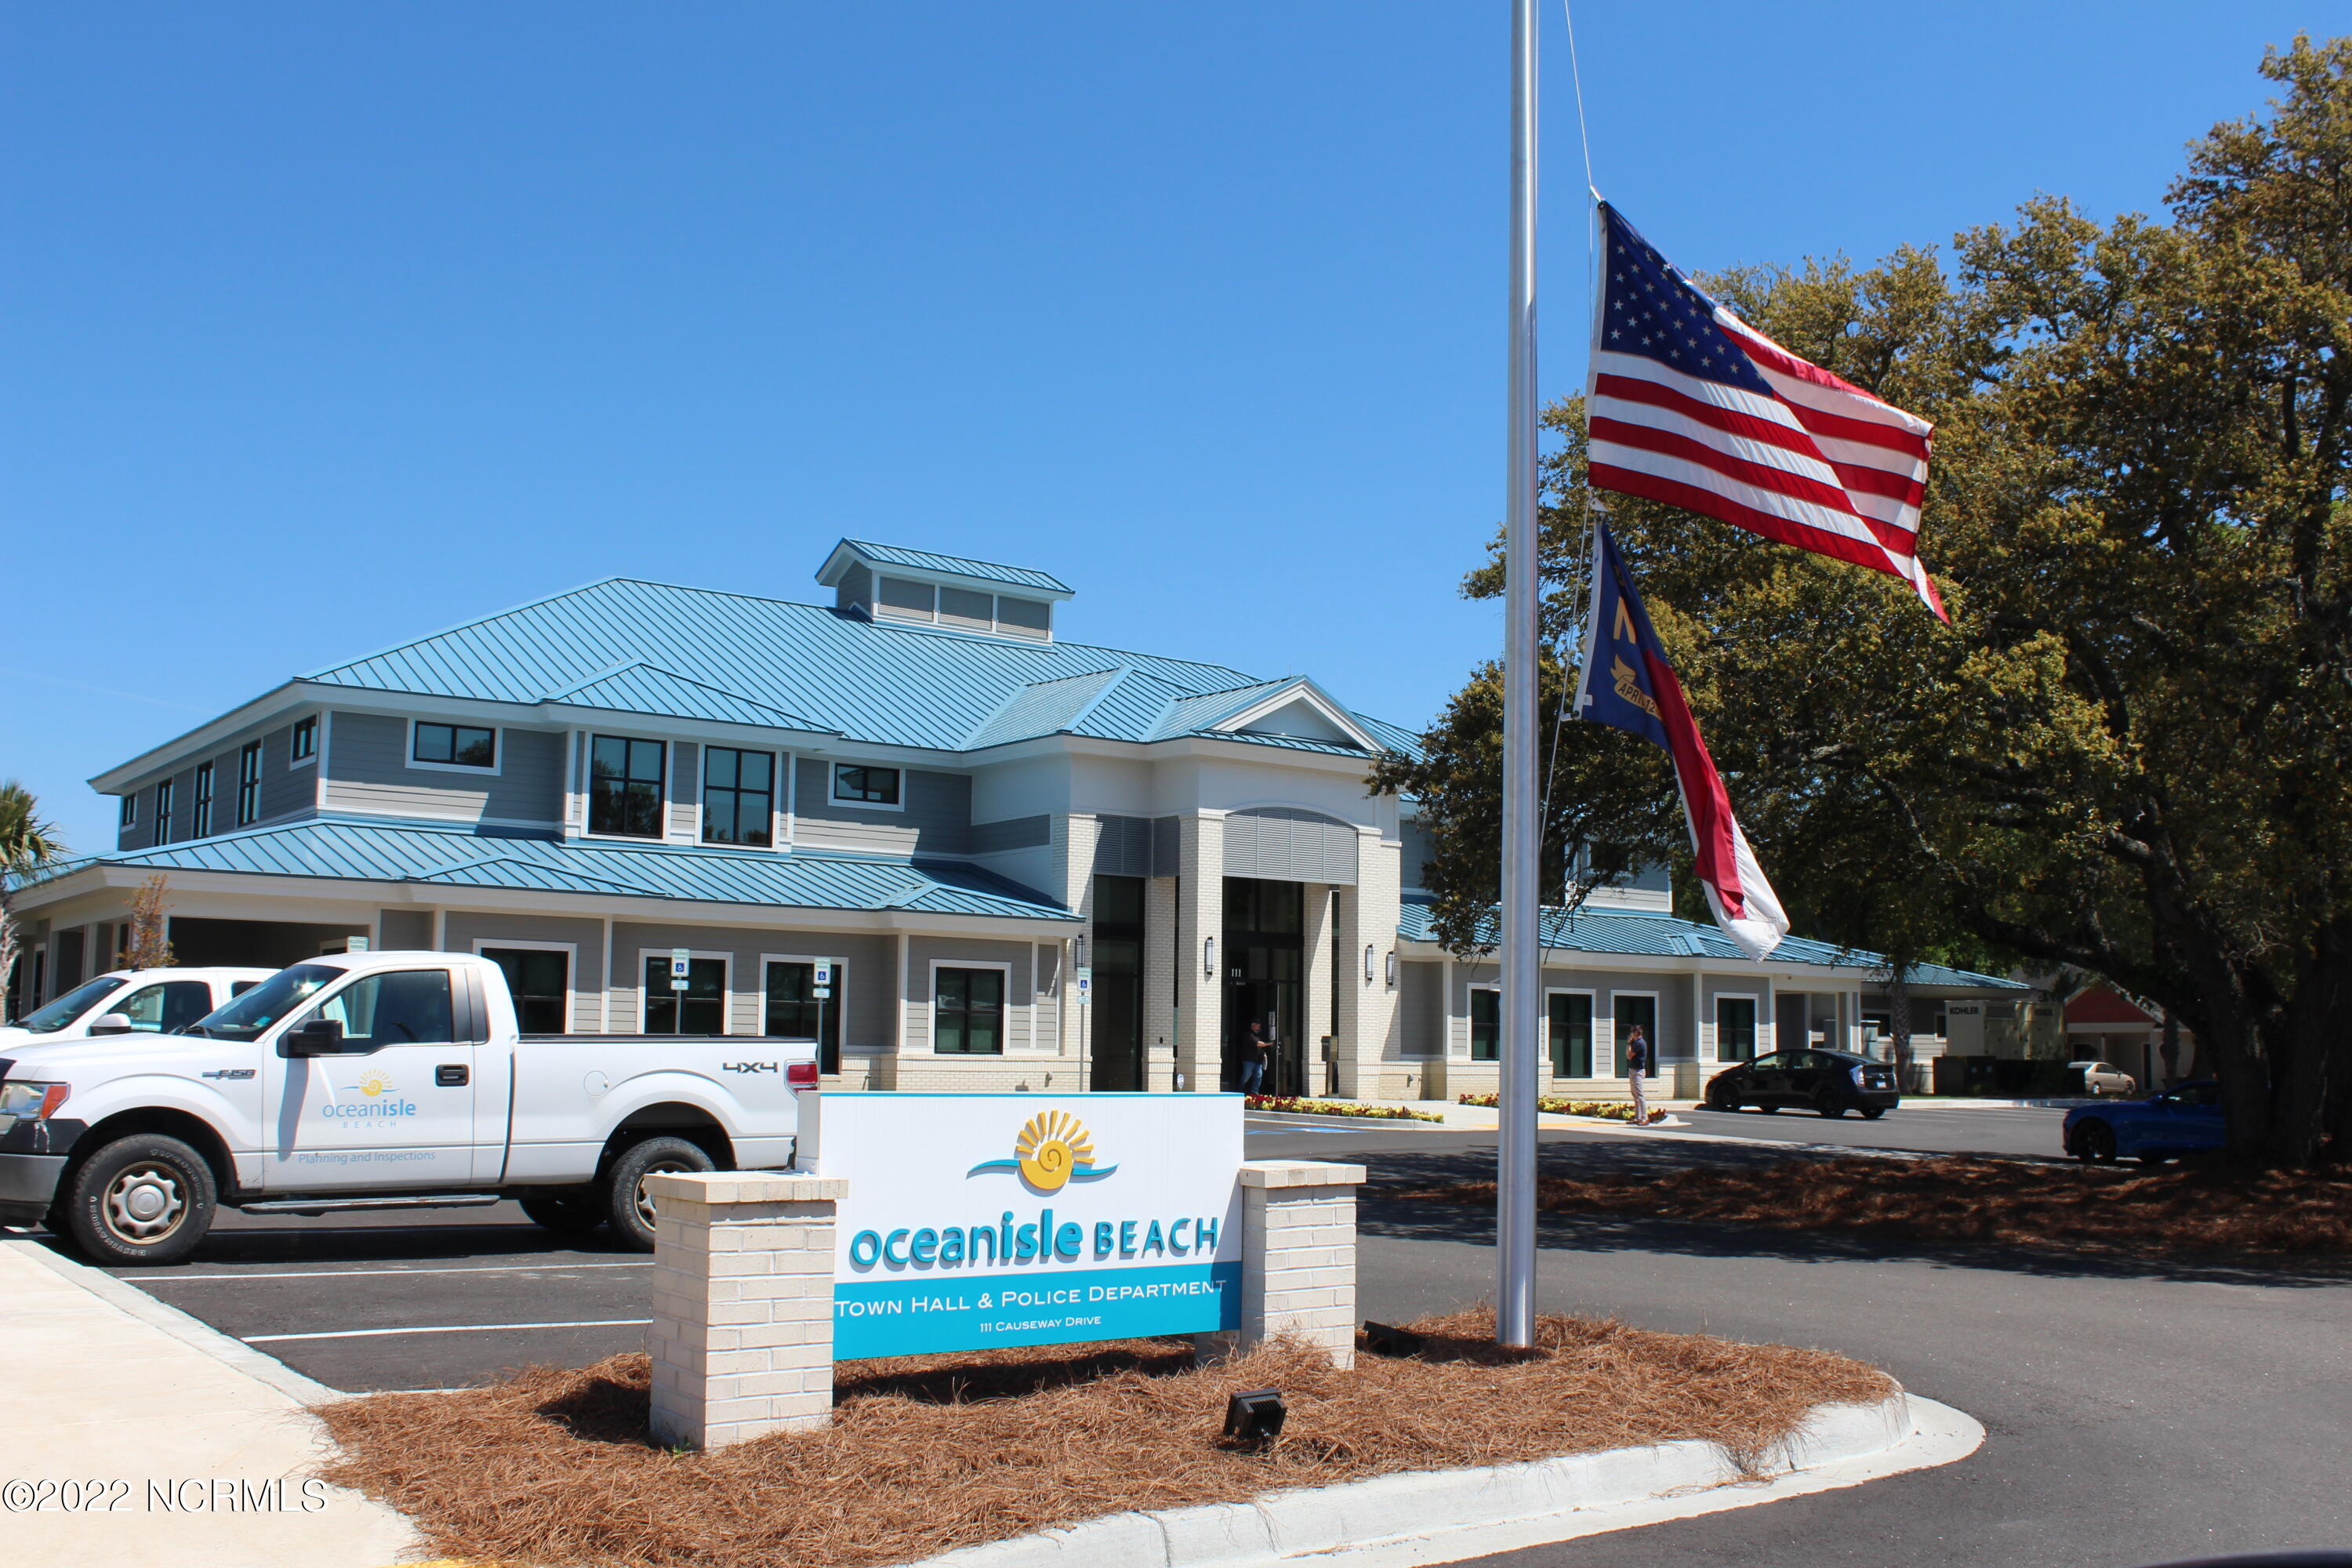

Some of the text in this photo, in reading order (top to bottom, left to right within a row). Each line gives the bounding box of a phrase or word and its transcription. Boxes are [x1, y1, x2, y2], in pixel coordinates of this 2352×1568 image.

[1232, 968, 1241, 978] 111
[1949, 1007, 1979, 1015] KOHLER
[299, 1151, 436, 1164] Planning and Inspections
[1094, 1216, 1218, 1254] BEACH
[978, 1292, 993, 1309] &
[979, 1323, 992, 1333] 111
